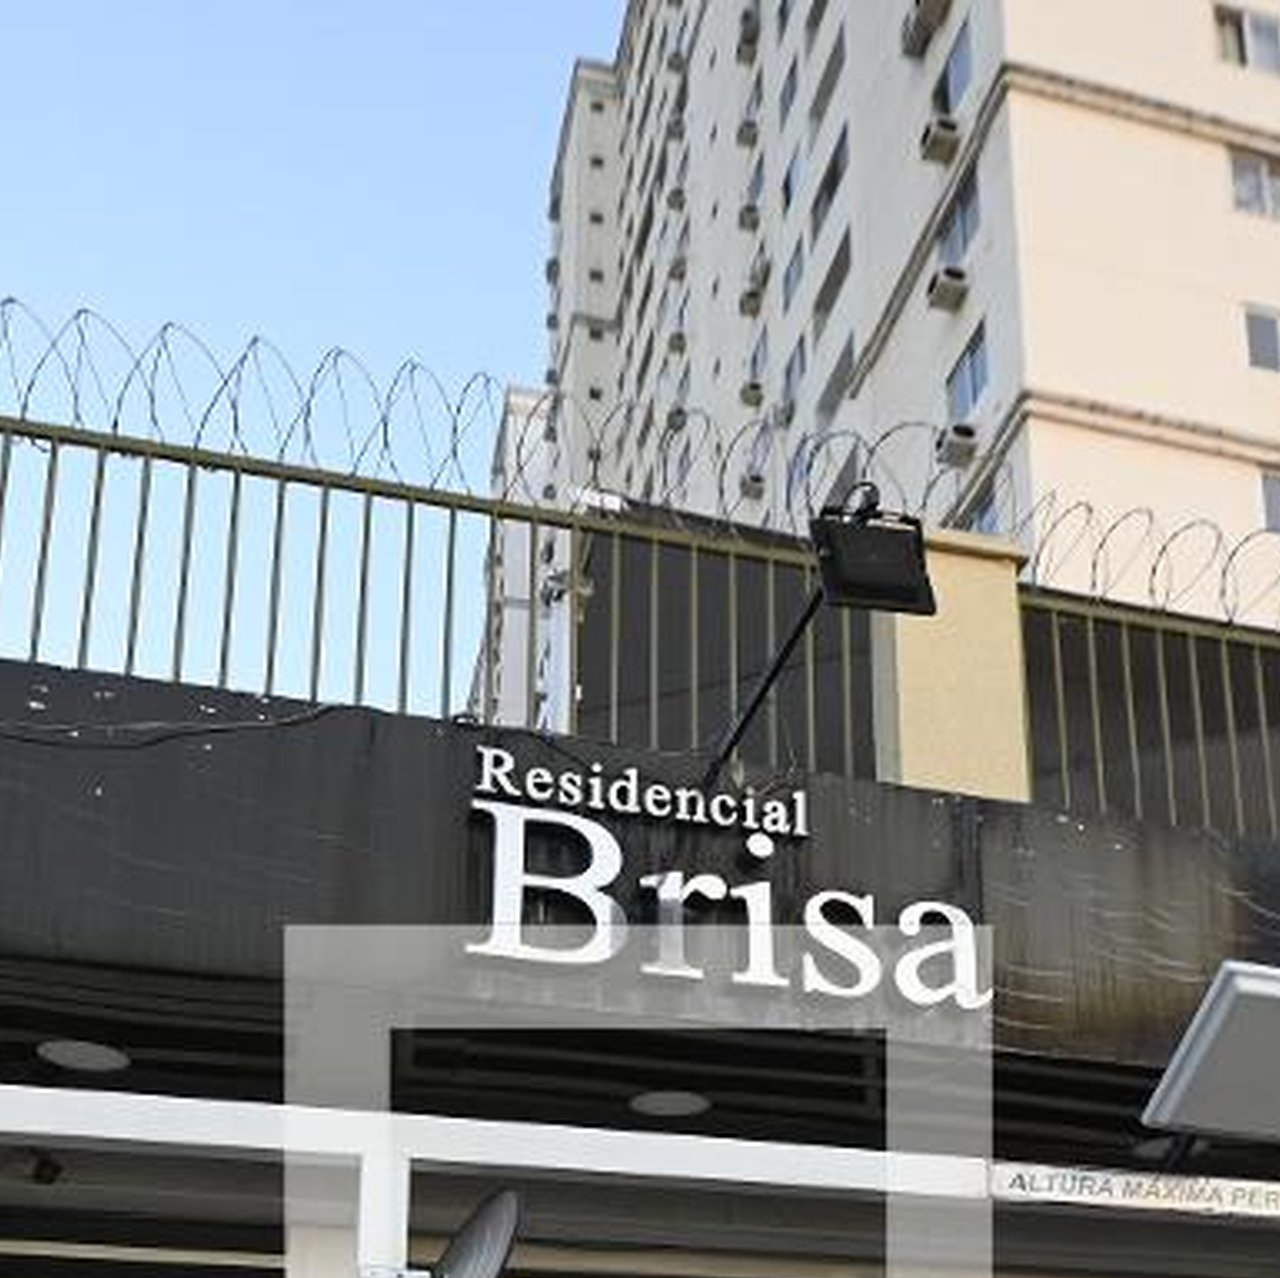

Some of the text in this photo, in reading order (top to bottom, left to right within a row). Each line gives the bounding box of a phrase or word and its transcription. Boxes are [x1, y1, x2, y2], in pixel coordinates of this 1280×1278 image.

[475, 744, 810, 838] Residencial
[465, 798, 994, 1012] Brisa
[1008, 1172, 1114, 1197] ALTURA
